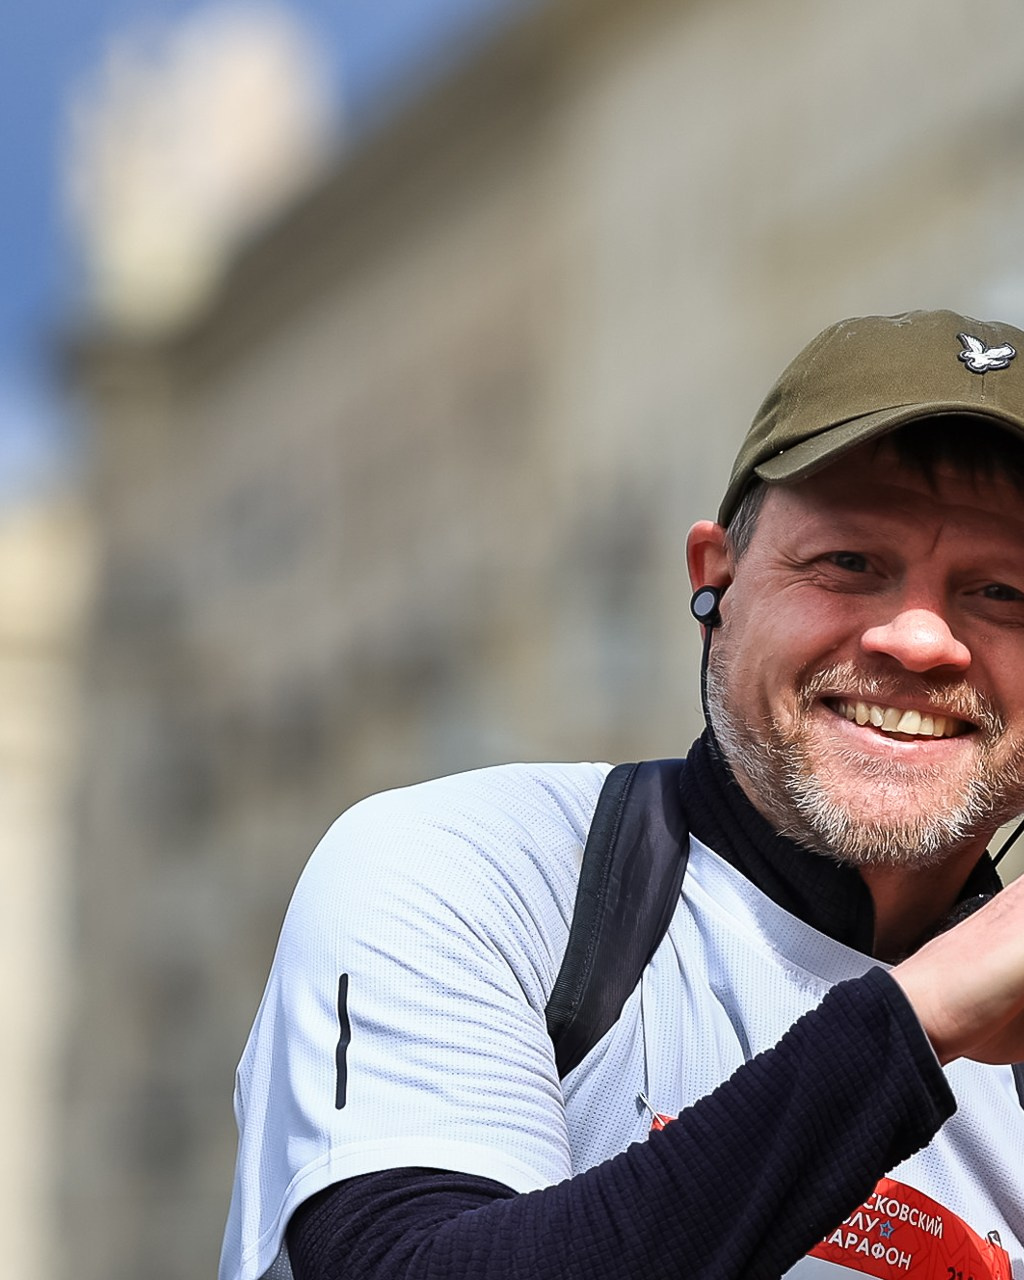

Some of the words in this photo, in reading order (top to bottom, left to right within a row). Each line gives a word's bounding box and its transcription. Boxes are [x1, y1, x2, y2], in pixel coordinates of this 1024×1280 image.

[842, 1213, 879, 1232] ЛУ
[862, 1194, 943, 1240] СКОВСКИЙ
[823, 1228, 912, 1271] АРАФОН
